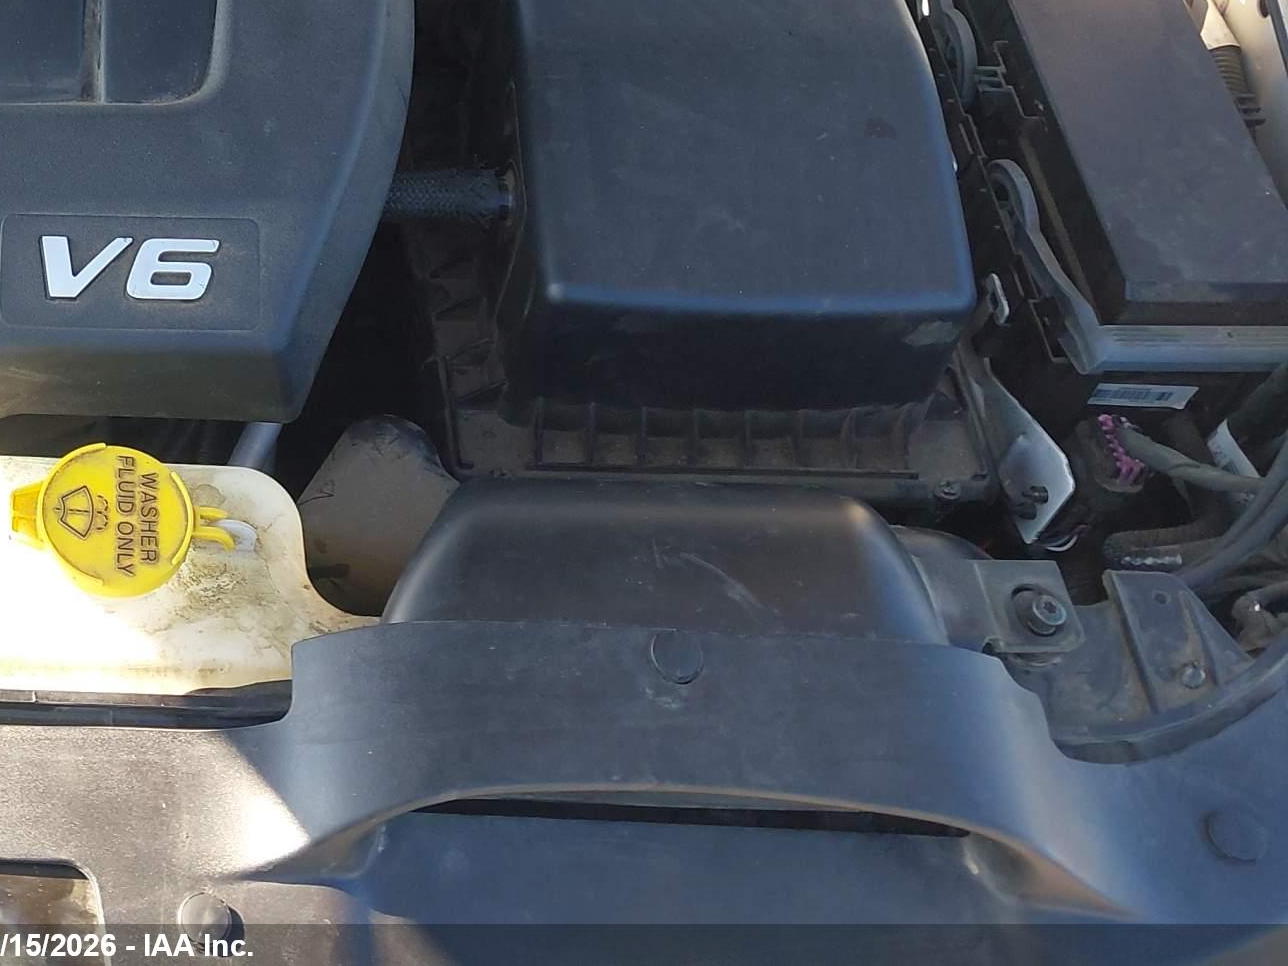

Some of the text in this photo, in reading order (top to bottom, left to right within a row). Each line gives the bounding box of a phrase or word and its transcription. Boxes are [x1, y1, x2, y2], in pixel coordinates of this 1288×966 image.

[40, 235, 221, 301] V6
[116, 455, 137, 578] FLUID ONLY
[139, 471, 159, 565] WASHER
